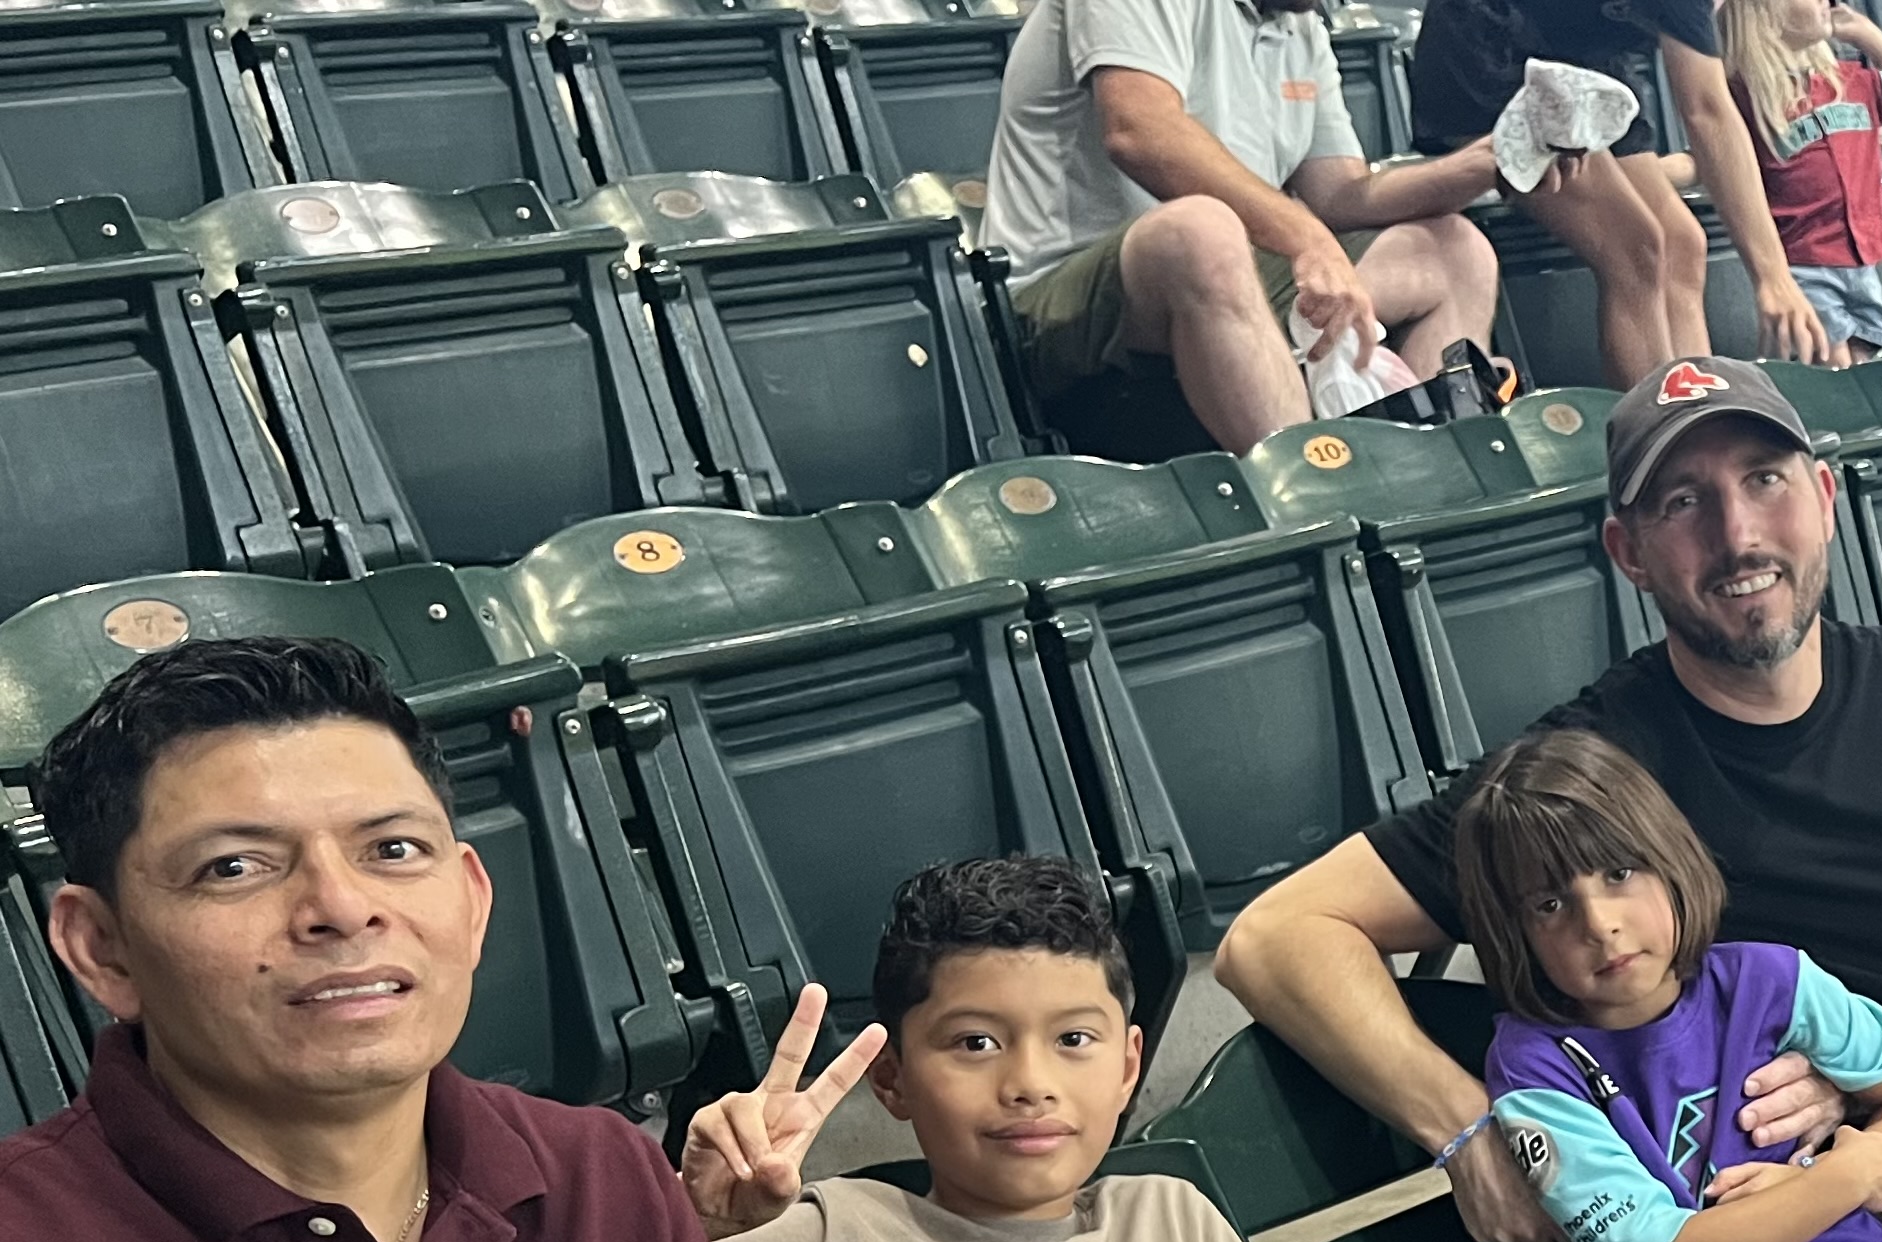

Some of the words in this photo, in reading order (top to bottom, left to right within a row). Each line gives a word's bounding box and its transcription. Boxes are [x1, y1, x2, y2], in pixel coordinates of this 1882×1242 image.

[1314, 443, 1341, 462] 10
[636, 541, 661, 562] 8
[132, 611, 153, 634] 7
